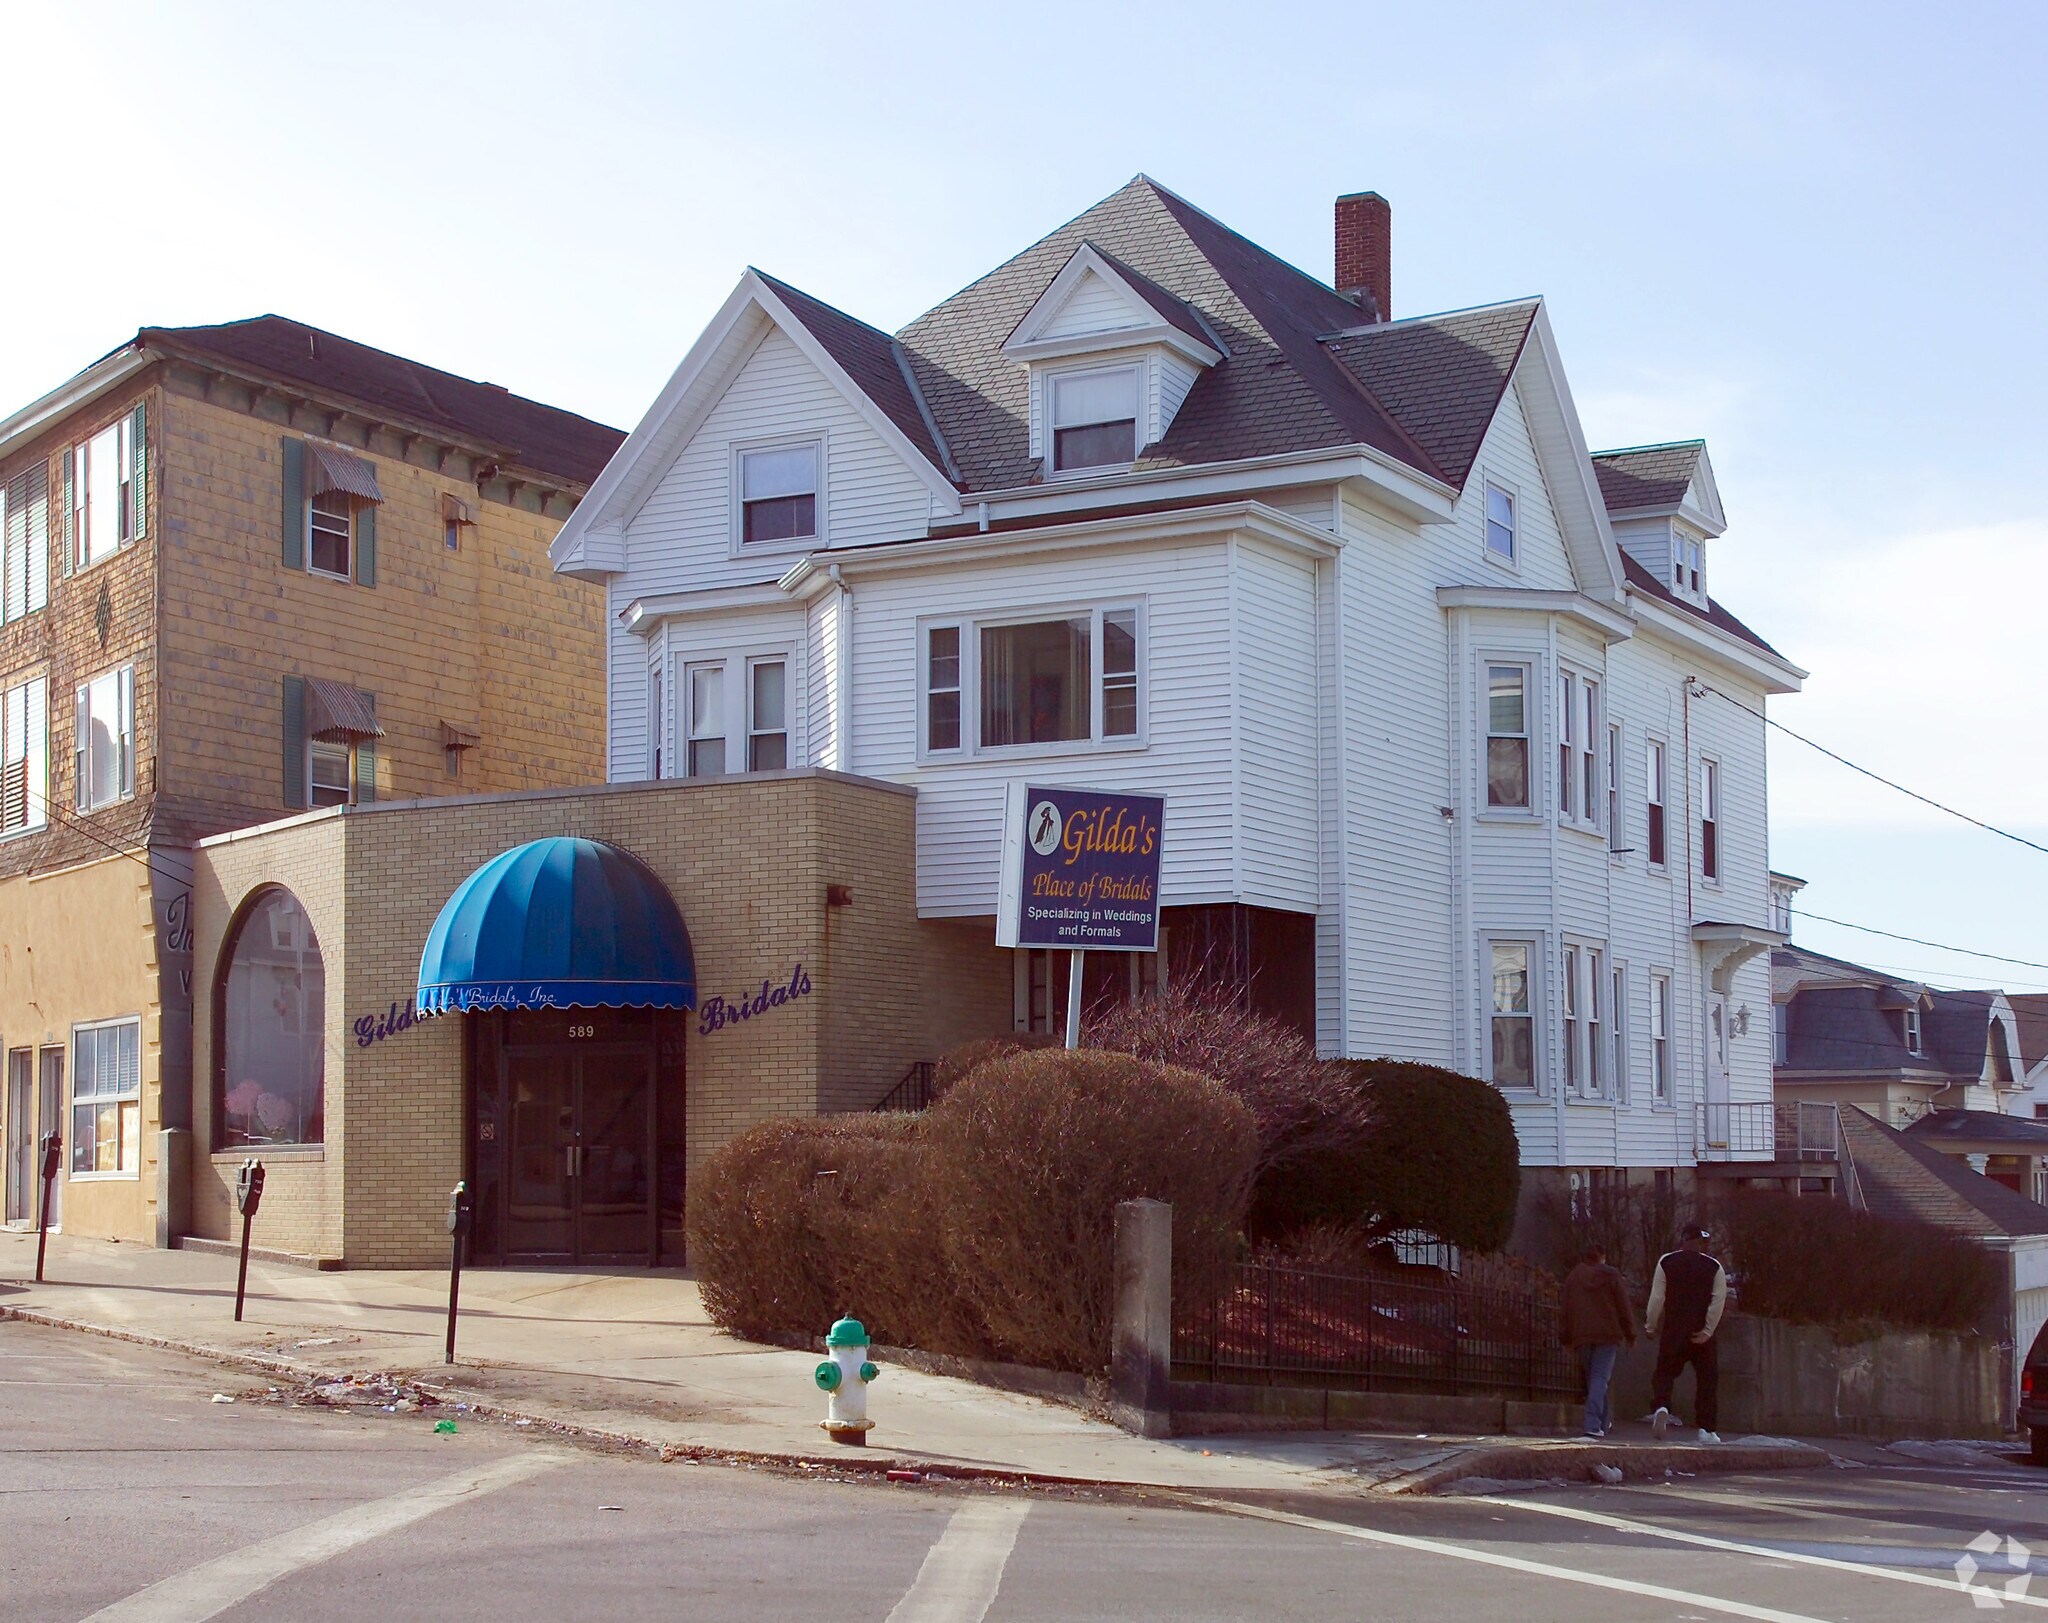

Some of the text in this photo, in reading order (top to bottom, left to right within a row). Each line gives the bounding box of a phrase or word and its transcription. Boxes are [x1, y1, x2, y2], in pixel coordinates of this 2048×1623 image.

[1063, 806, 1156, 866] Gilda's
[1033, 870, 1152, 907] Place of Bridals
[1028, 905, 1152, 925] Specializing in Weddings
[1058, 925, 1122, 938] and Formals
[468, 985, 521, 1004] Bridals,
[528, 986, 557, 1003] Inc.
[699, 963, 811, 1035] Bridals
[568, 1025, 594, 1038] 589
